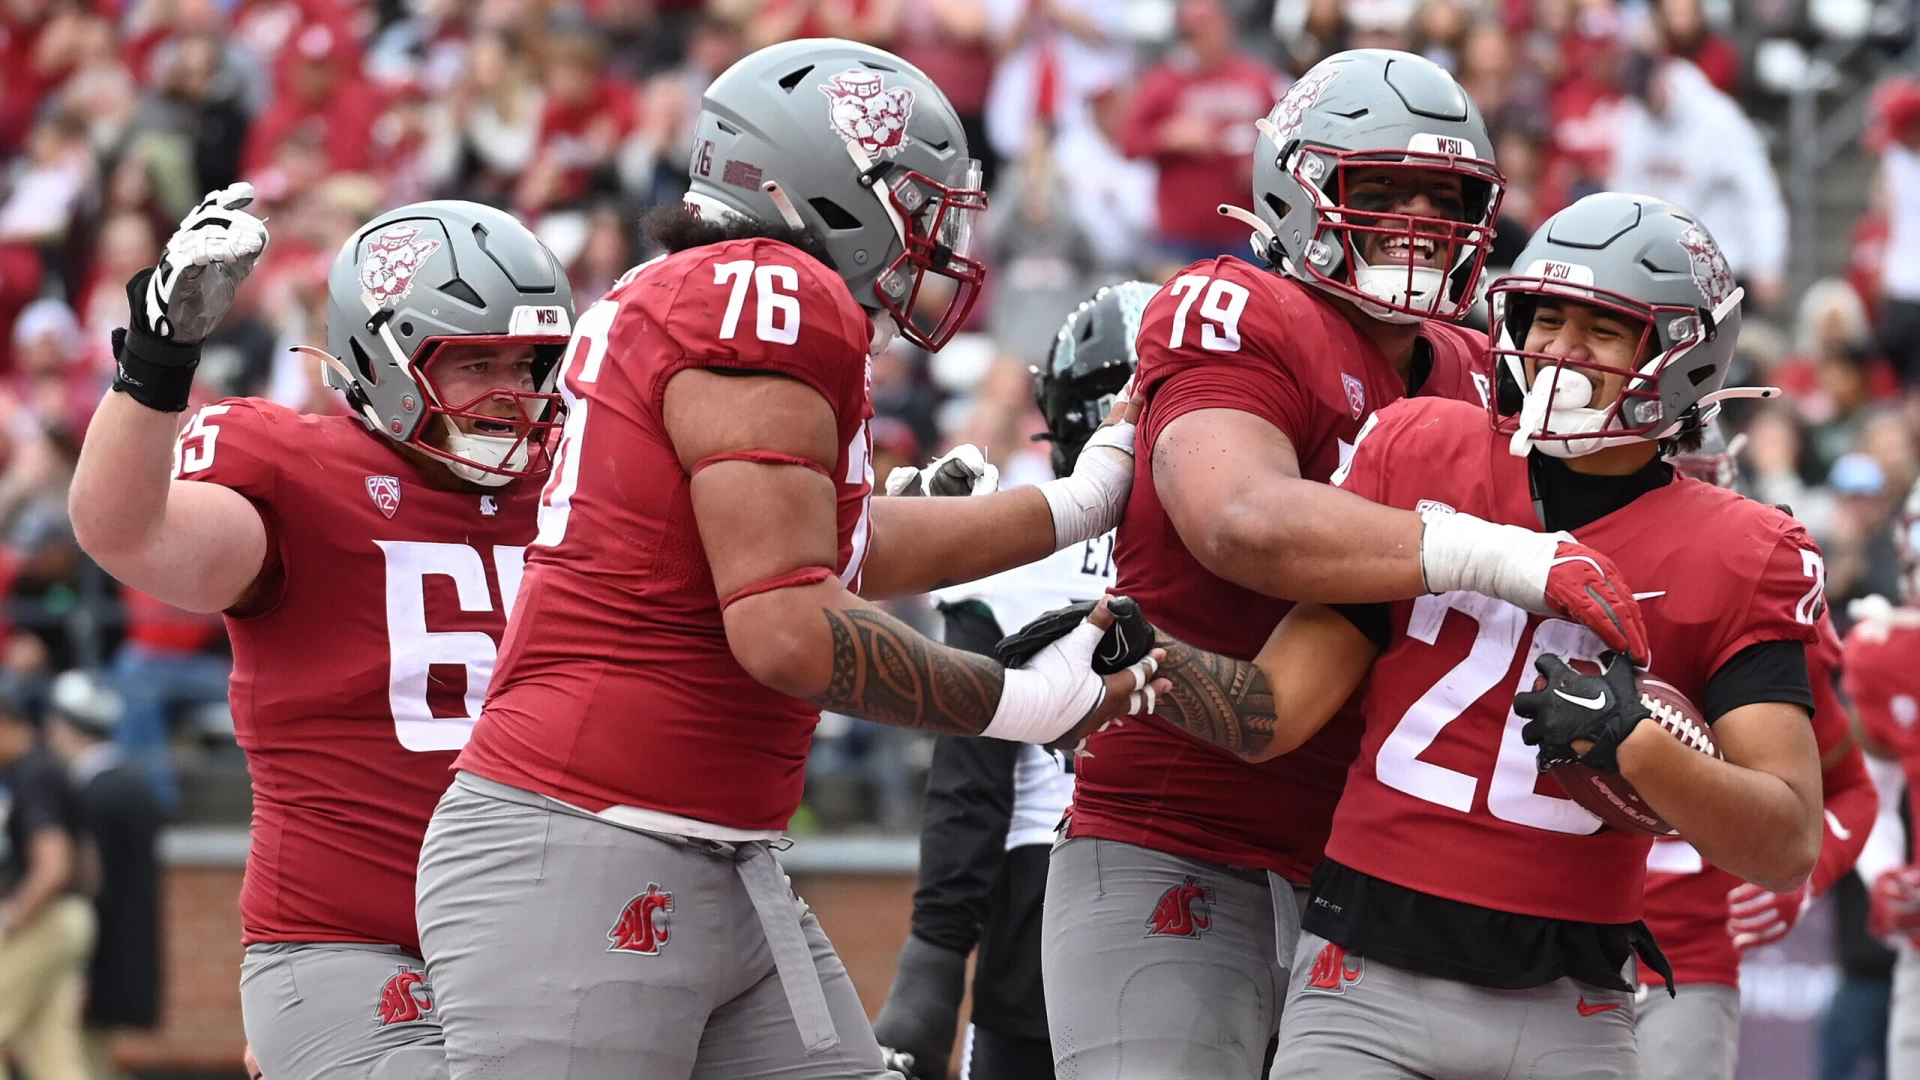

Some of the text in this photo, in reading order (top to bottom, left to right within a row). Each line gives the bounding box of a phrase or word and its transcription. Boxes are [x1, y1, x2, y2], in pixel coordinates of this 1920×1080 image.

[840, 81, 880, 97] WSC
[1436, 137, 1462, 155] WSU
[1544, 262, 1571, 279] WSU
[713, 260, 799, 345] 76
[536, 309, 558, 324] WSU
[1169, 274, 1249, 352] 79
[378, 494, 395, 510] 12
